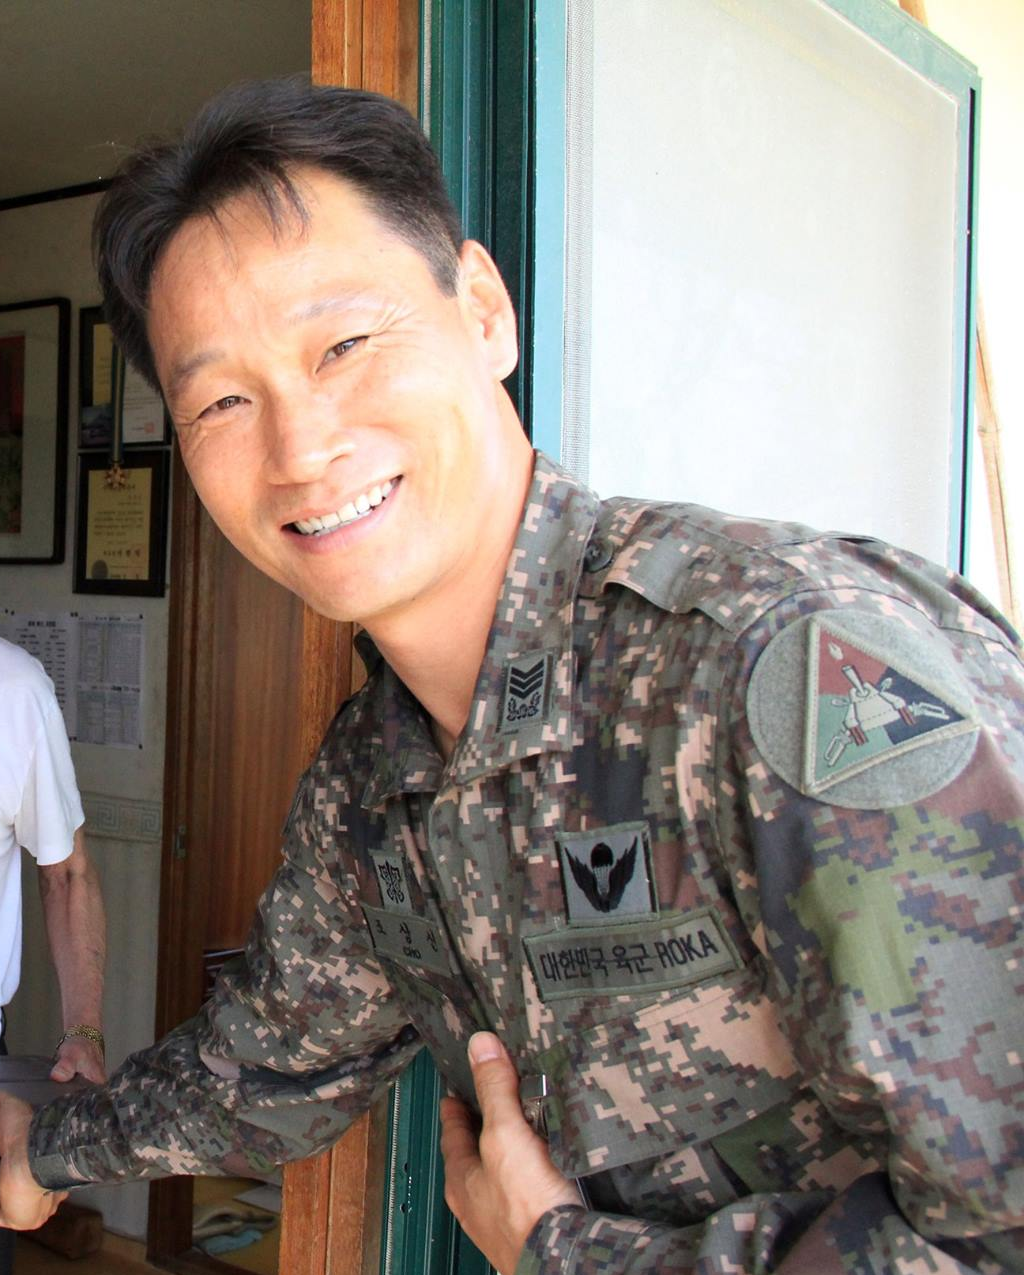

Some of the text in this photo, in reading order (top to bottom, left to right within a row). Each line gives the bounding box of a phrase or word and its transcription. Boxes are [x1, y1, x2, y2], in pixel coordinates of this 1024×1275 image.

[539, 930, 719, 982] 대한민국 육군 ROKA
